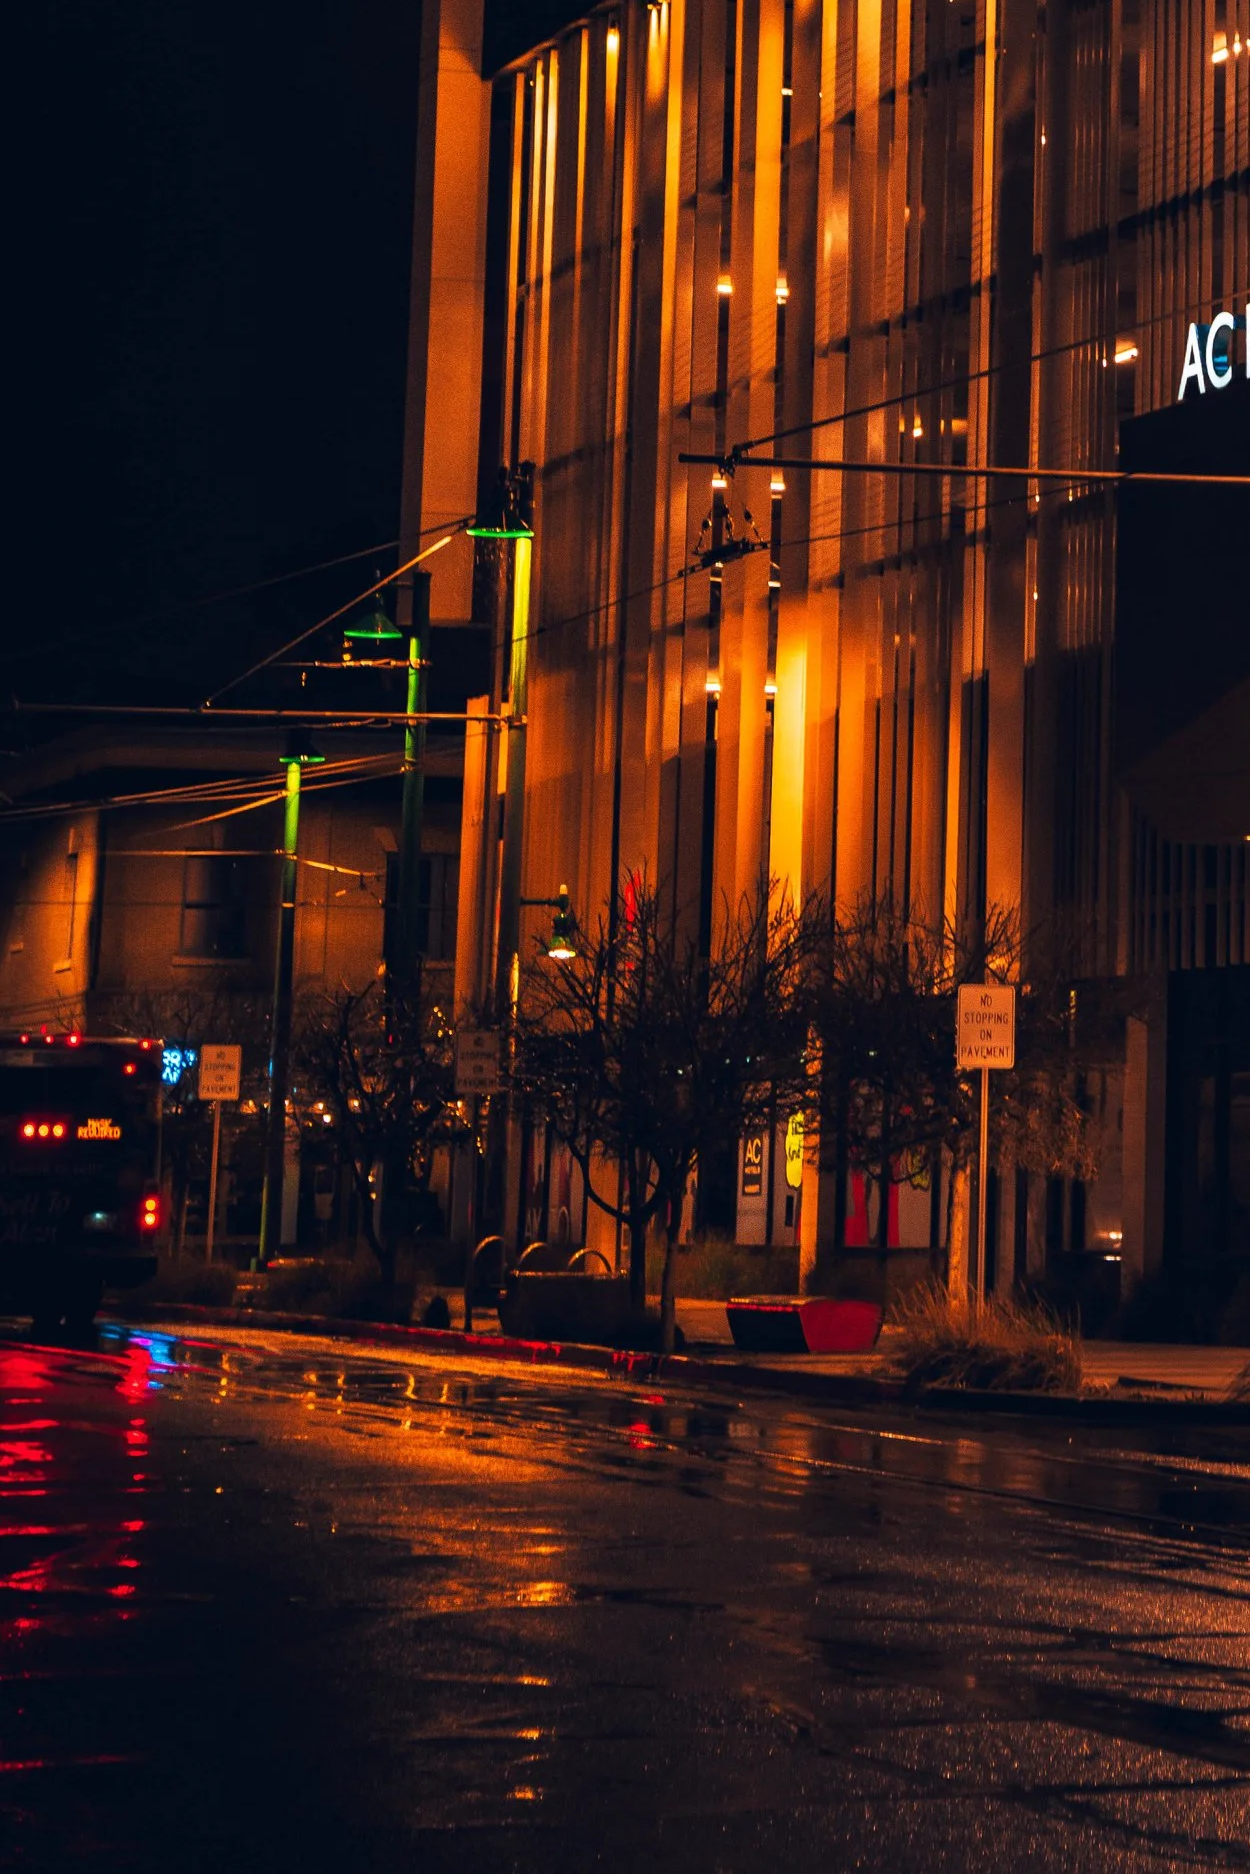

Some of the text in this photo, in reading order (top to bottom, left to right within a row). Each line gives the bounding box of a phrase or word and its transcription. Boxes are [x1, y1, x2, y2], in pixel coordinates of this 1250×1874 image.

[1178, 310, 1235, 401] AC
[980, 994, 993, 1007] NO
[964, 1012, 1009, 1024] STOPPING
[980, 1029, 992, 1041] ON
[961, 1046, 1010, 1057] PAVEMENT
[745, 1137, 761, 1164] AC
